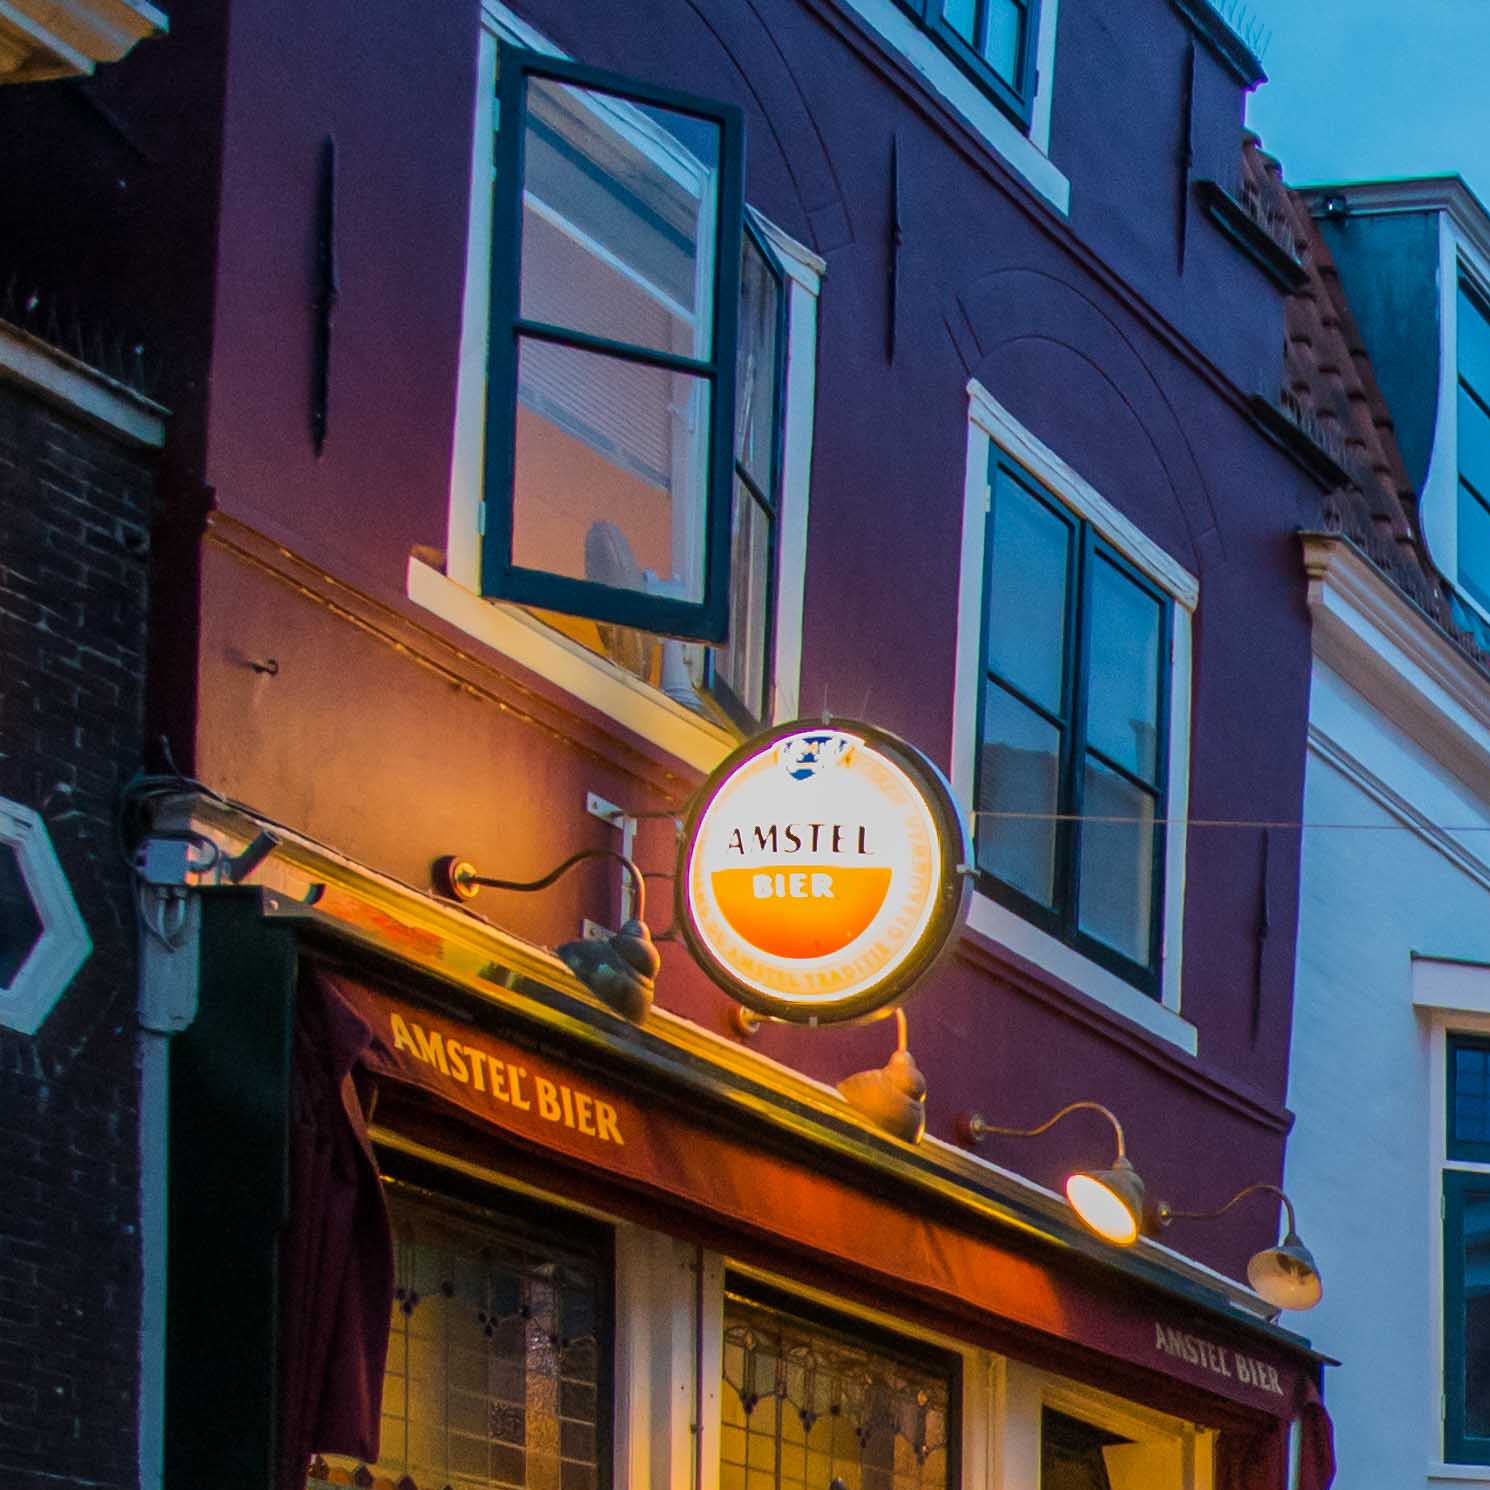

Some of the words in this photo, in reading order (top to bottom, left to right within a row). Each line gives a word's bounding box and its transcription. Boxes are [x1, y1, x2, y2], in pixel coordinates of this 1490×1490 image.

[726, 822, 875, 856] AMSTEL
[752, 872, 835, 900] BIER
[390, 1012, 531, 1112] AMSTEL
[534, 1075, 625, 1147] BIER
[1154, 1321, 1231, 1377] AMSTEL
[1234, 1352, 1285, 1396] BIER
